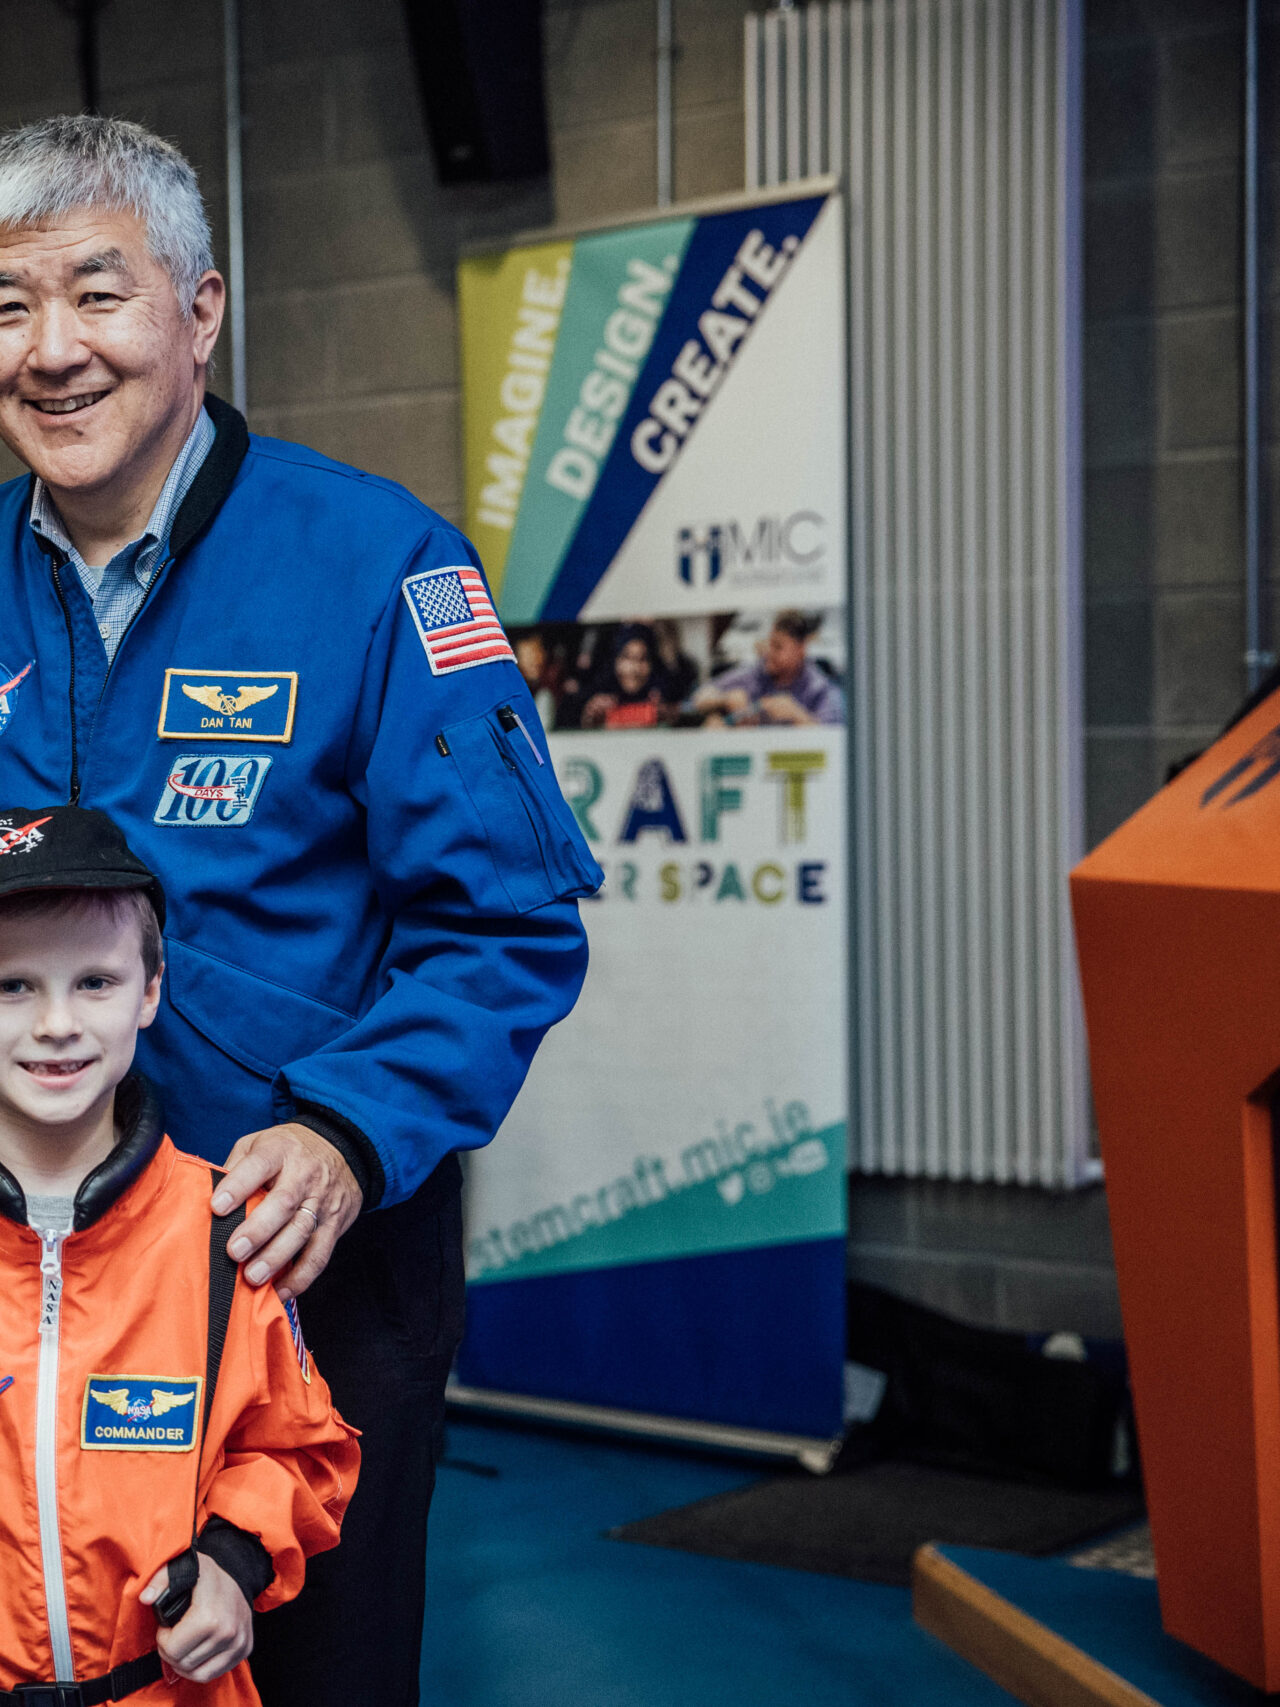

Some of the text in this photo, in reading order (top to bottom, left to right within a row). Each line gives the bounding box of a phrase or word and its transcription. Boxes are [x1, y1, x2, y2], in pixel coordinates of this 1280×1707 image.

[545, 254, 679, 501] DESIGN.
[630, 228, 802, 475] CREATE.
[476, 256, 570, 530] IMAGINE.
[723, 510, 826, 567] MIC
[200, 716, 253, 730] DAN TANI
[159, 758, 260, 822] 100
[194, 788, 225, 799] DAYS
[561, 749, 826, 845] RAFT
[658, 861, 826, 904] SPACE
[42, 1280, 58, 1325] NASA
[95, 1425, 185, 1440] COMMANDER
